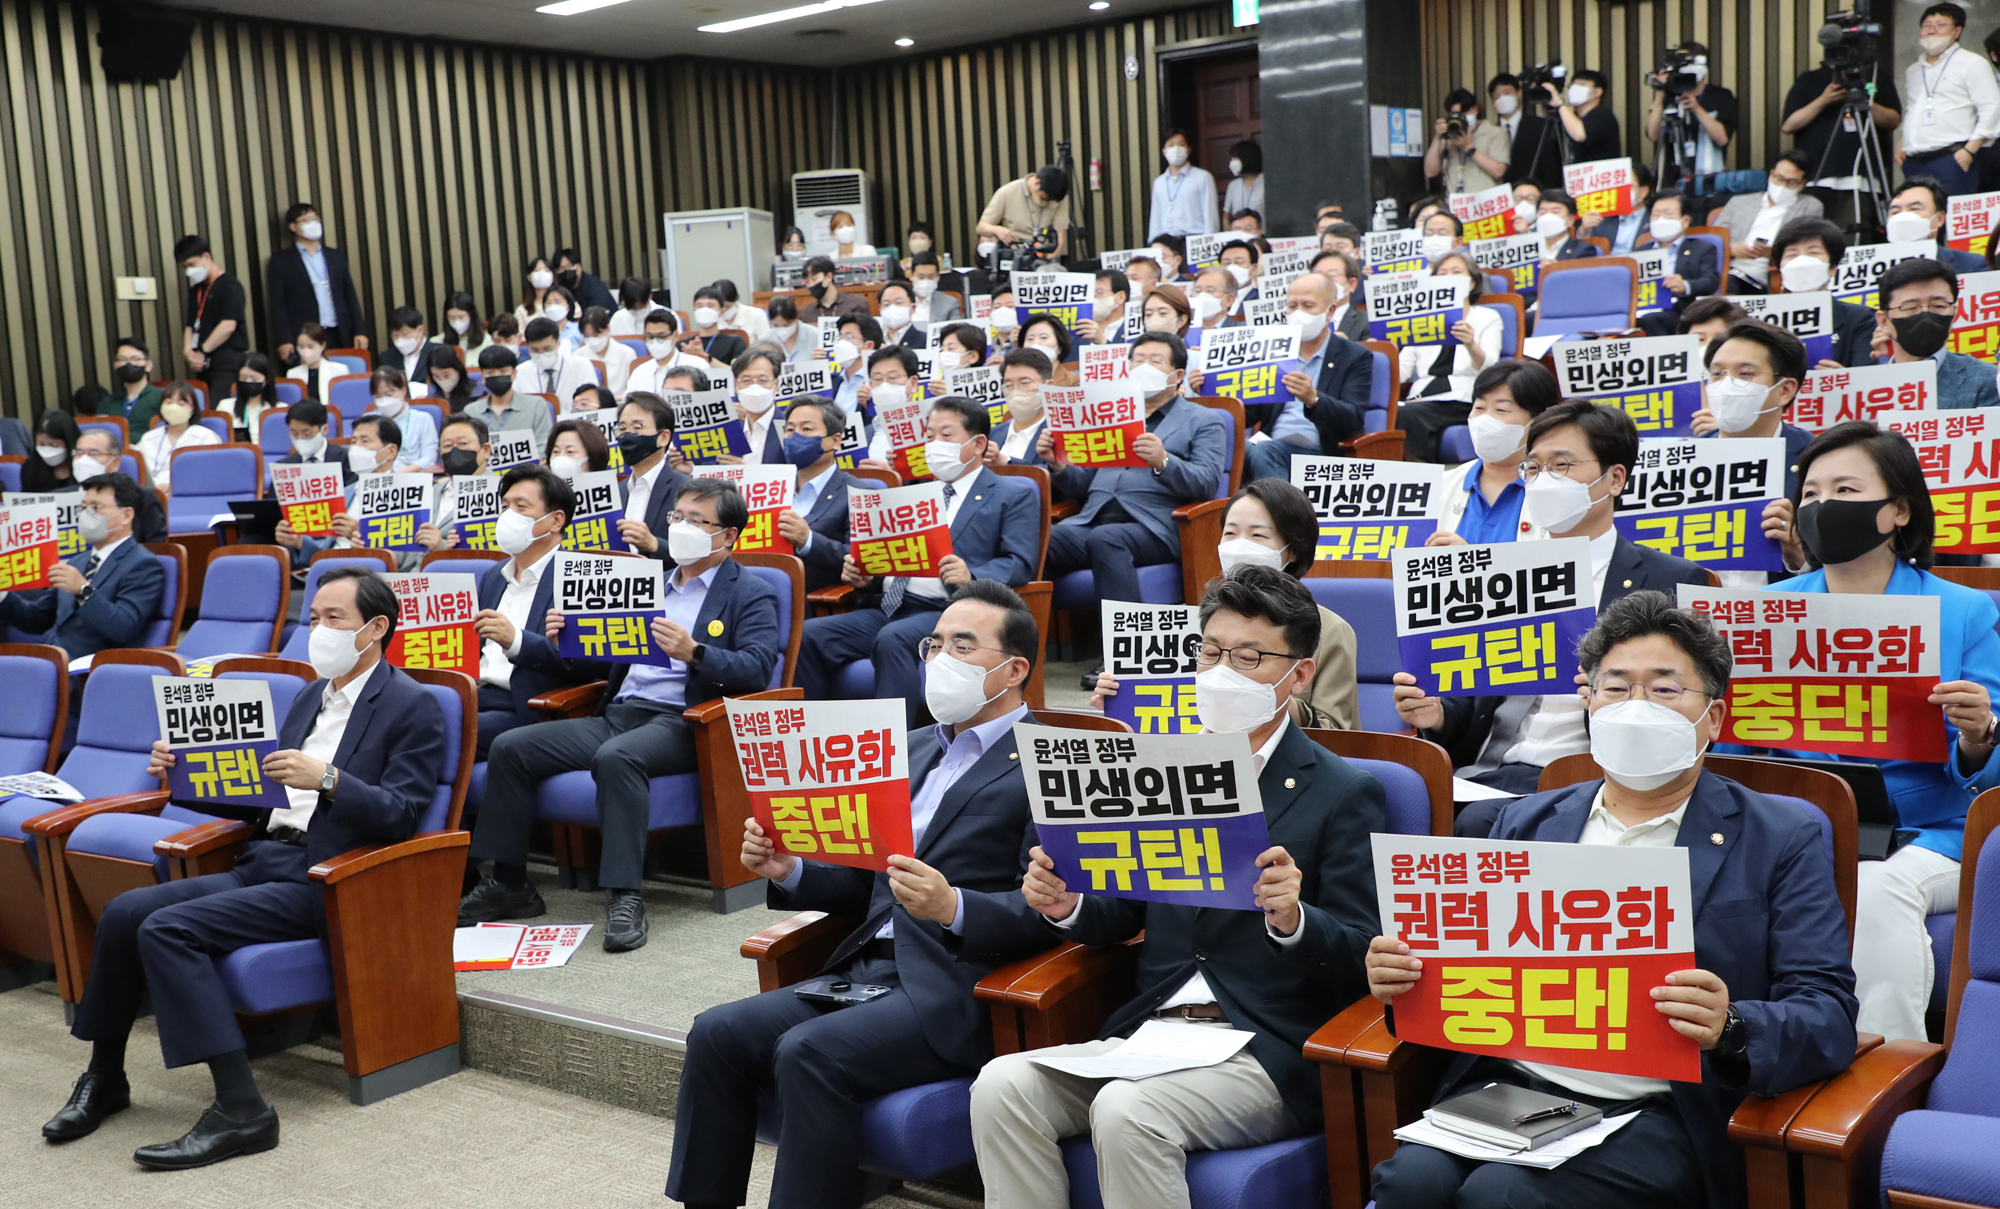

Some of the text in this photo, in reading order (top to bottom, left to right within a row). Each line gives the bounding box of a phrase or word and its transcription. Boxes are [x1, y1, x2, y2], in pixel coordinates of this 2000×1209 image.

[1588, 169, 1626, 189] 사유화
[1473, 194, 1509, 216] 사유화
[1575, 188, 1618, 217] 중단!
[1953, 199, 1981, 214] 윤석열
[1462, 214, 1505, 244] 중단!
[1953, 211, 1989, 236] 권력
[1854, 248, 1876, 262] 정부
[1019, 284, 1088, 304] 민생외면
[1373, 280, 1418, 296] 윤석열 정부
[1374, 286, 1456, 317] 민생외면
[1745, 299, 1766, 313] 정부
[1210, 329, 1255, 346] 윤석열 정부
[1386, 313, 1446, 345] 규탄!
[1085, 350, 1108, 363] 윤석열
[1206, 337, 1292, 370] 민생외면
[1565, 342, 1631, 363] 윤석열 정부
[776, 370, 824, 396] 생외면
[1085, 361, 1114, 382] 권력
[1216, 364, 1277, 399] 규탄!
[1569, 352, 1688, 393] 민생외면
[1819, 373, 1850, 392] 정부
[1067, 390, 1085, 403] 정부
[1049, 397, 1136, 428] 권력 사유화
[1945, 414, 1984, 438] 정부
[679, 428, 730, 459] 규탄!
[888, 421, 916, 447] 권력
[1063, 428, 1126, 464] 중단!
[487, 440, 532, 467] 생외면
[1666, 444, 1696, 465] 정부
[300, 475, 338, 499] 사유화
[726, 469, 743, 483] 정부
[1304, 463, 1375, 482] 윤석열 정부
[1615, 459, 1768, 512] 민생외면
[362, 485, 424, 515] 민생외면
[458, 491, 500, 519] 민생외
[864, 494, 881, 509] 정부
[1303, 482, 1431, 518] 민생외면
[288, 502, 332, 533] 중단!
[367, 514, 414, 549] 규탄!
[879, 499, 939, 534] 사유화
[6, 517, 52, 547] 사유화
[1634, 509, 1746, 561] 규탄!
[564, 560, 613, 576] 윤석열 정부
[859, 535, 930, 574] 중단!
[1406, 548, 1492, 582] 윤석열 정부
[412, 577, 429, 593] 정부
[562, 576, 655, 611] 민생외면
[1407, 561, 1577, 630] 민생외면
[426, 591, 473, 622] 사유화
[1113, 610, 1188, 632] 윤석열 정부
[1763, 599, 1807, 624] 정부
[404, 628, 463, 669] 중단!
[577, 616, 649, 657] 규탄!
[1789, 625, 1926, 674] 사유화
[1431, 622, 1557, 693] 규탄!
[163, 683, 215, 705] 윤석열 정부
[166, 701, 265, 745] 민생외면
[733, 708, 806, 737] 윤석열 정부
[1730, 683, 1888, 743] 중단!
[739, 728, 895, 786] 권력 사유화
[1034, 738, 1137, 764] 윤석열 정부
[185, 748, 263, 798] 규탄!
[1038, 760, 1240, 819] 민생외면
[769, 793, 874, 855] 중단!
[1076, 827, 1225, 891] 규탄!
[1391, 851, 1531, 885] 윤석열 정부
[1393, 886, 1675, 951] 권력 사유화
[515, 943, 554, 966] 사유화
[1440, 966, 1629, 1051] 중단!
